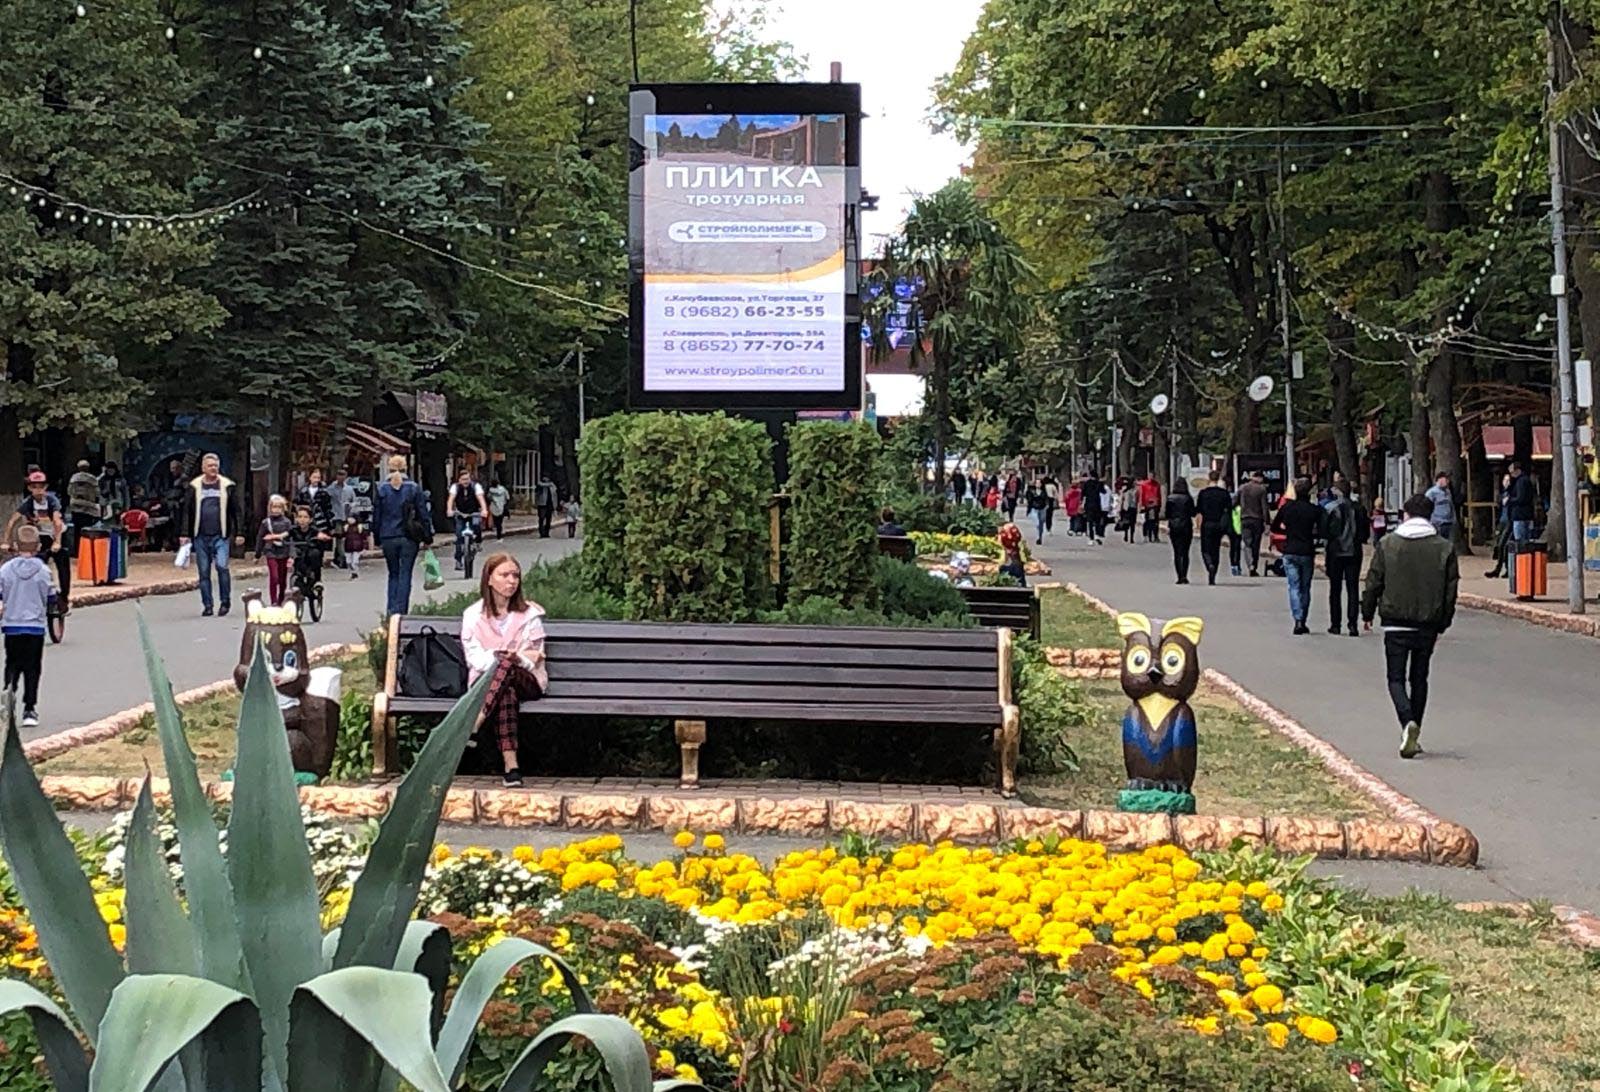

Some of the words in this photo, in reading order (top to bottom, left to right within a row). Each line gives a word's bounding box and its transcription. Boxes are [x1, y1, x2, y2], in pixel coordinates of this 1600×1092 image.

[665, 166, 823, 189] ПЛИТКА
[686, 194, 805, 207] тротуарная
[664, 306, 675, 317] 8
[680, 306, 740, 319] (9682)
[744, 306, 825, 317] 66-23-55
[664, 340, 675, 351] 8
[680, 340, 738, 353] (8652)
[743, 340, 825, 351] 77-70-74
[664, 365, 825, 378] www.stroypolimer26.ru
